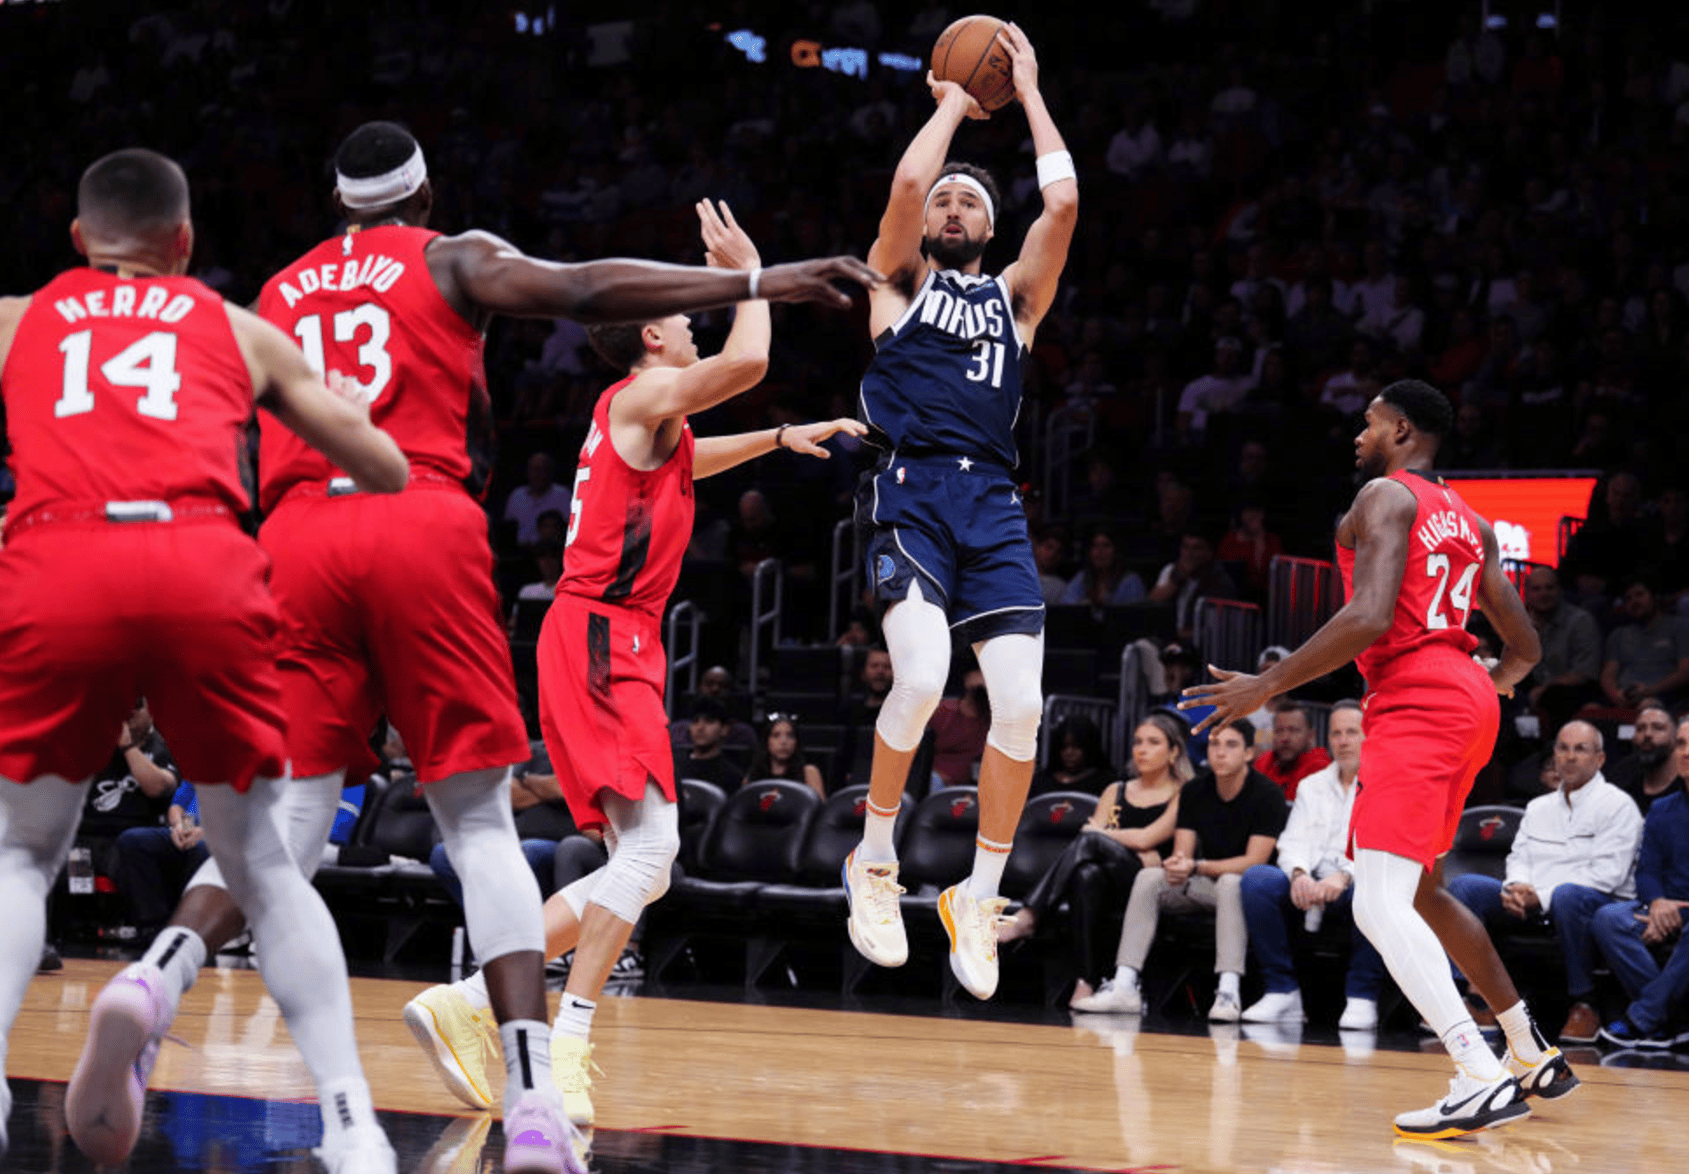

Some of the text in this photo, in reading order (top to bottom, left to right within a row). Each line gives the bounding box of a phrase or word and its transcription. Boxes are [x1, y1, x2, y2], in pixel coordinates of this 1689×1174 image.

[54, 285, 195, 323] HERRO
[54, 329, 182, 421] 14
[294, 302, 392, 403] 13
[965, 339, 1006, 389] 31
[1426, 552, 1481, 631] 24
